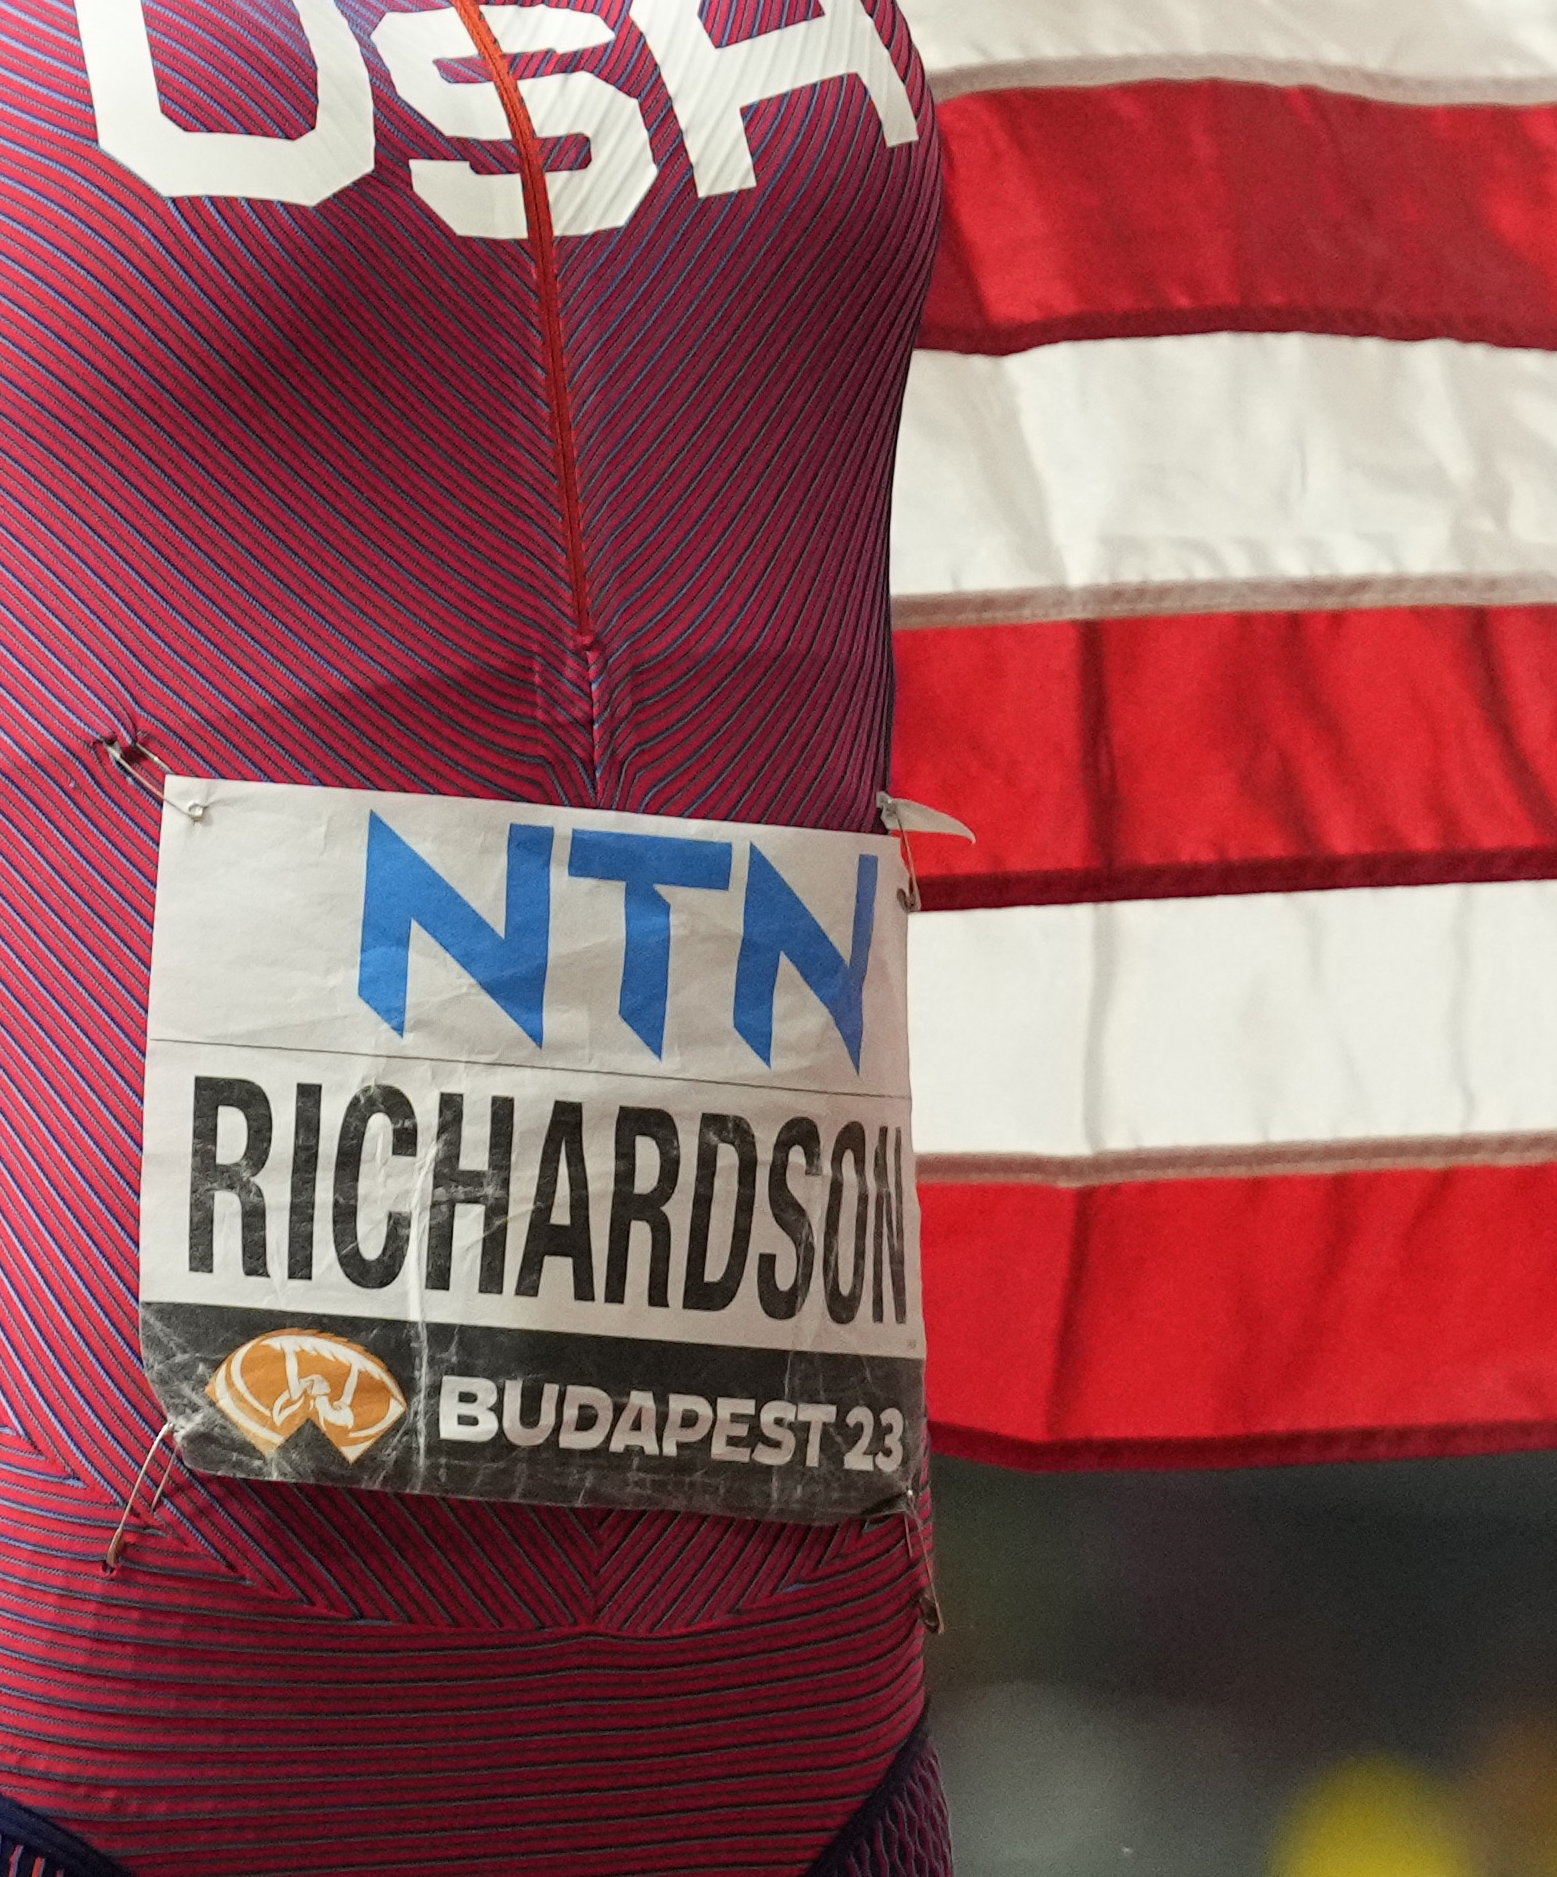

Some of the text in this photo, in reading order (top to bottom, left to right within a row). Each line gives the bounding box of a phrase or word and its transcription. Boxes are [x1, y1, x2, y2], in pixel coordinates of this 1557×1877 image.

[357, 809, 878, 1076] NTN
[188, 1075, 907, 1325] RICHARDSON
[438, 1375, 904, 1473] BUDAPEST 23
